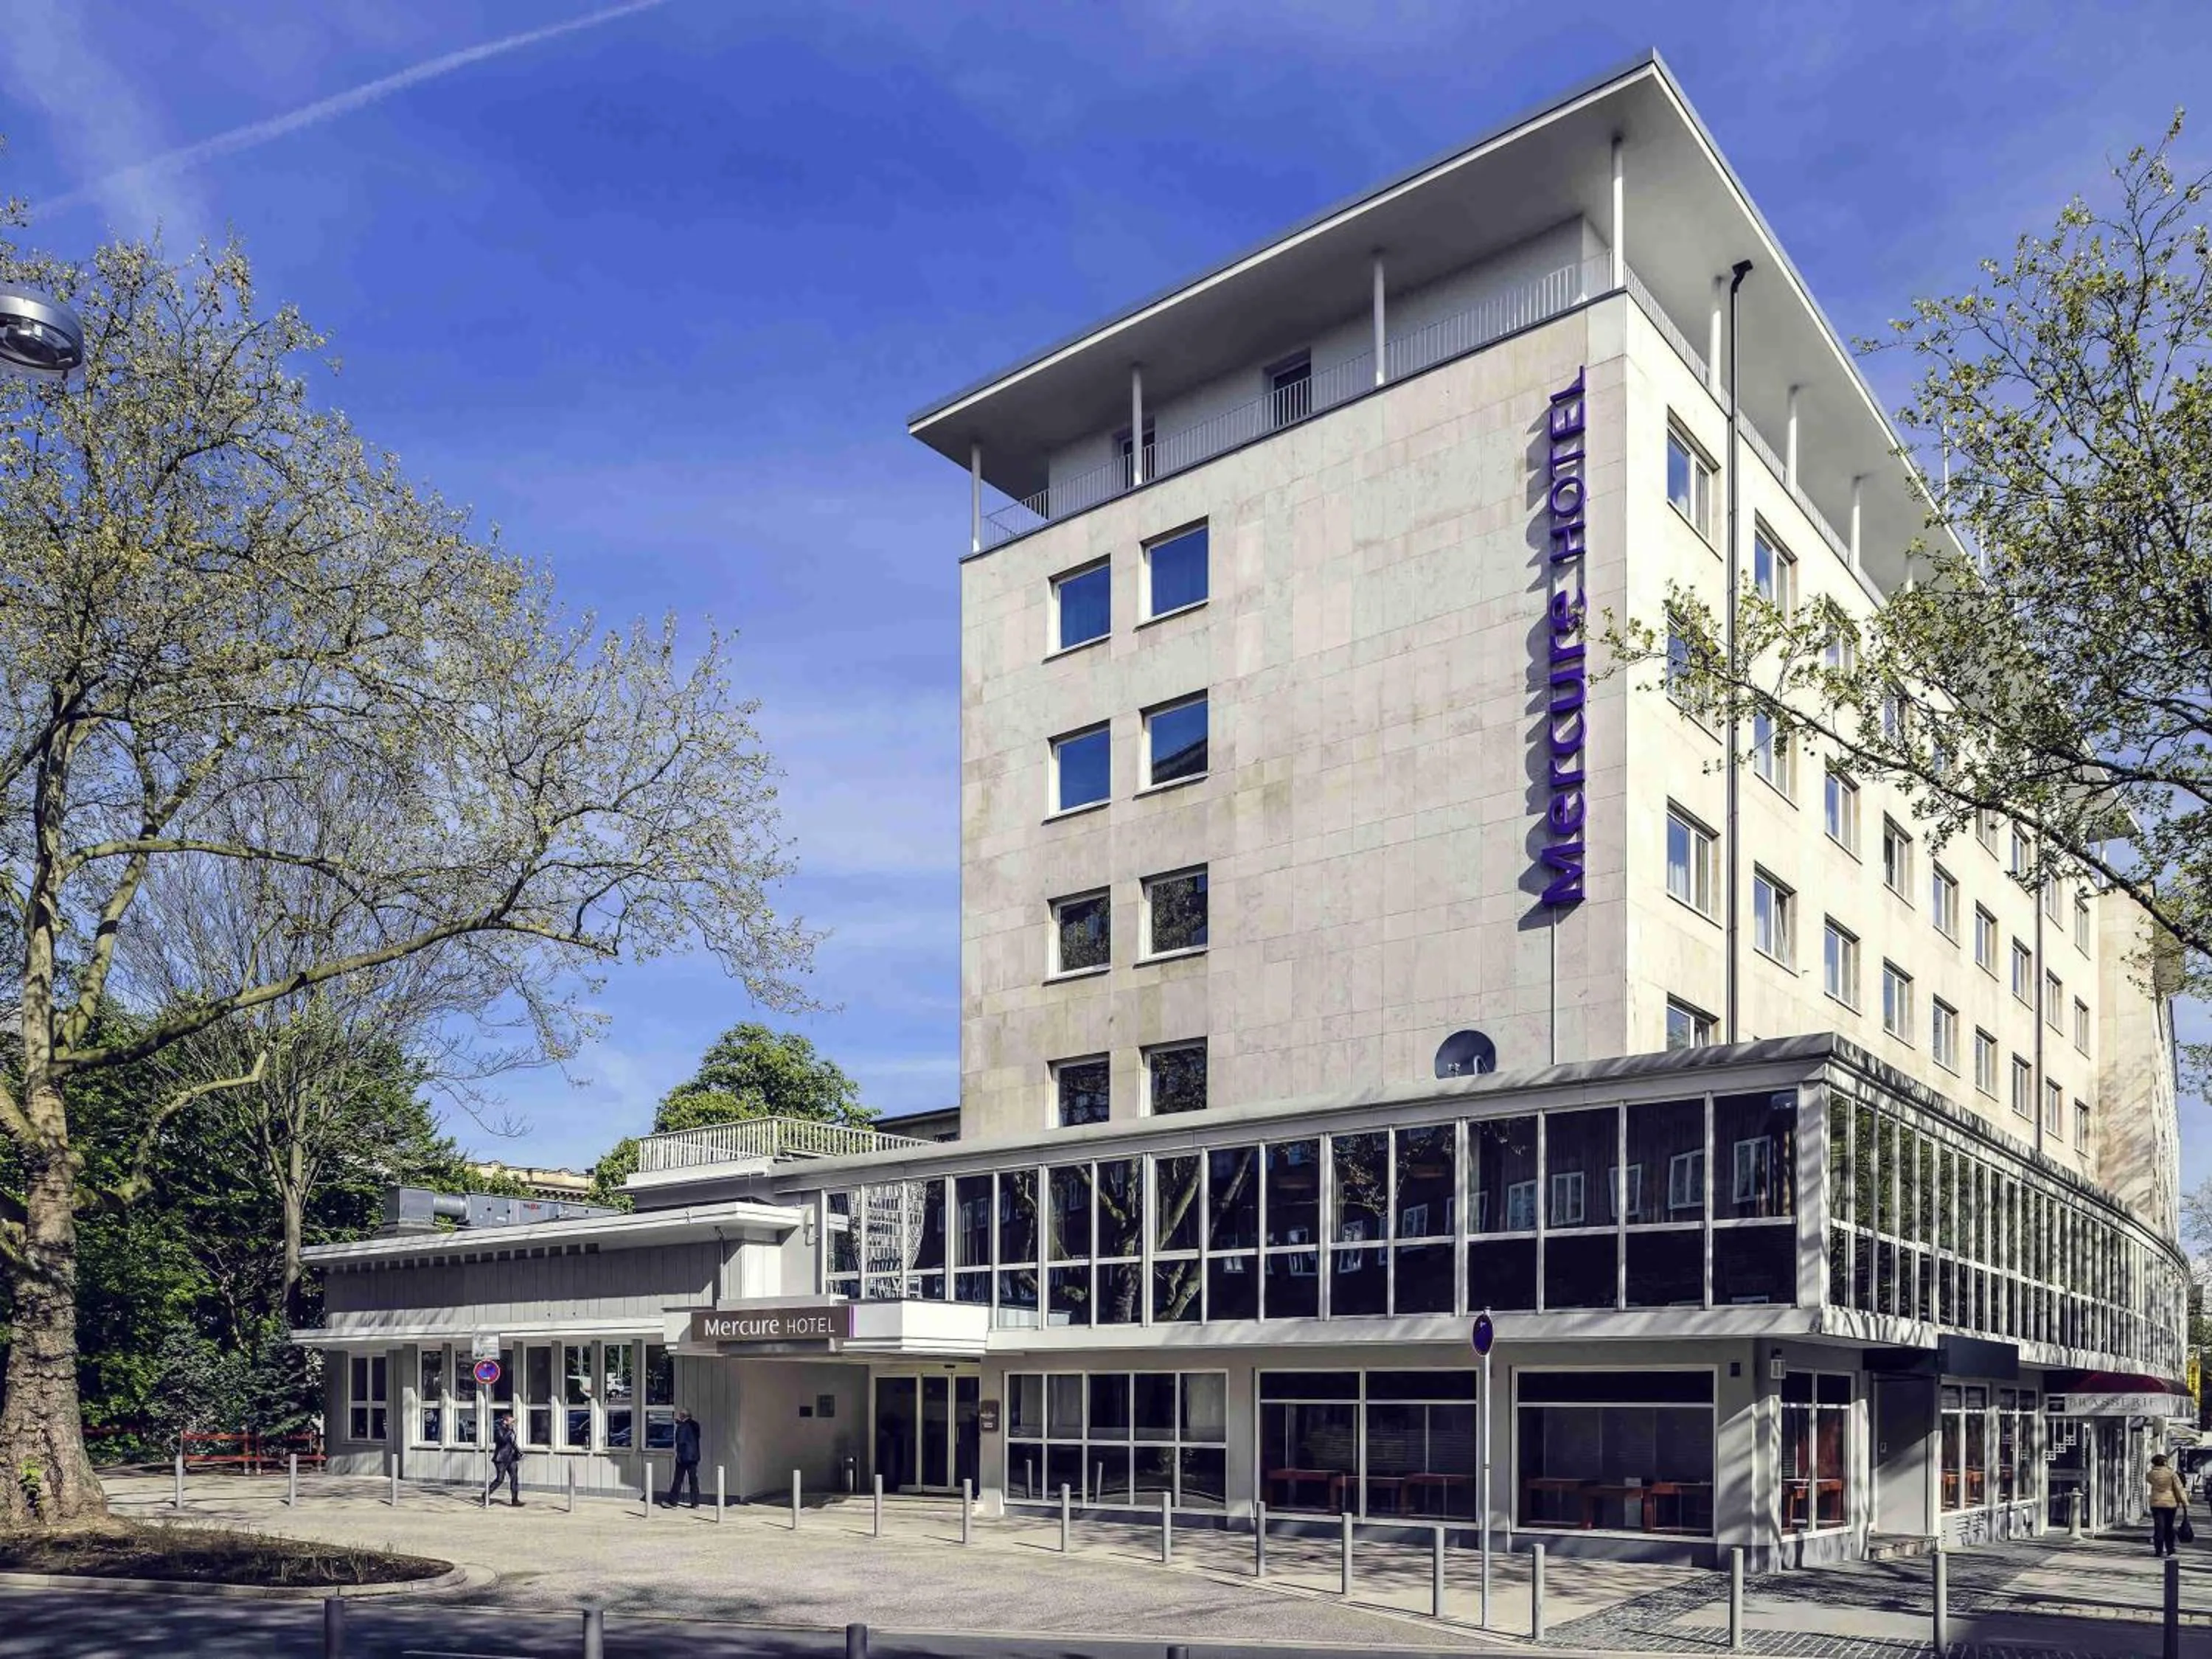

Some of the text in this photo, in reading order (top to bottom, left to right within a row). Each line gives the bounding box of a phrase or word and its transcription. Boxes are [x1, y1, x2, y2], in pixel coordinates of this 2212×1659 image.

[1542, 365, 1587, 908] Mercure HOTEL
[704, 1317, 836, 1337] Mercure HOTEL
[2069, 1397, 2157, 1408] BRASSERIE
